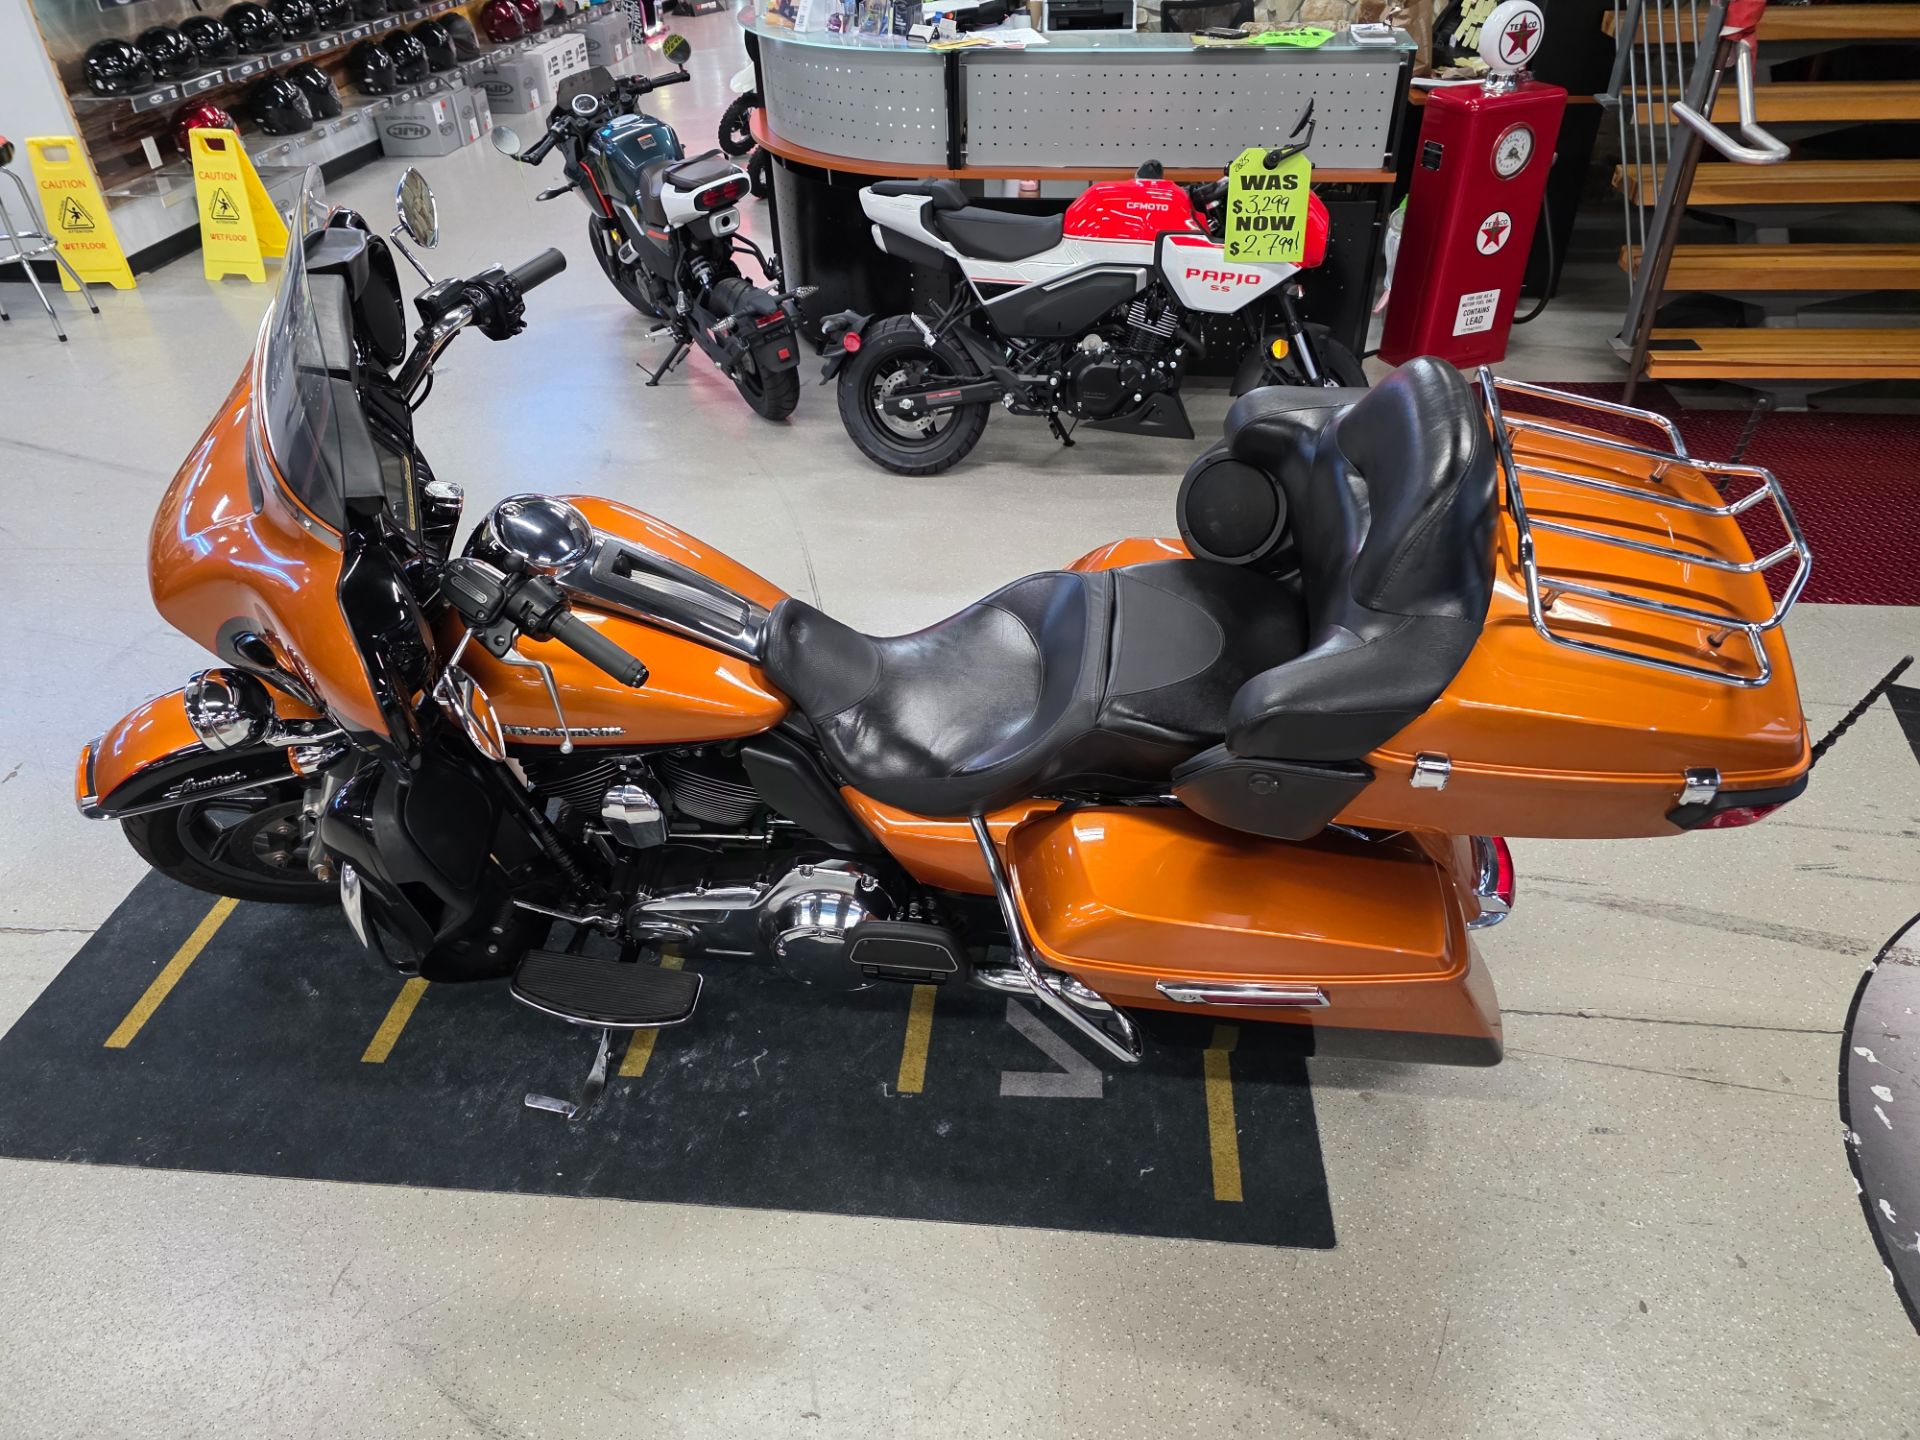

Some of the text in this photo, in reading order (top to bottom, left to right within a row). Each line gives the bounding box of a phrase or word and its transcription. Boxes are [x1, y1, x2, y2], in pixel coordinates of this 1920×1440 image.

[199, 171, 237, 181] CAUTION
[41, 180, 87, 189] CAUTION
[1240, 174, 1299, 191] WAS
[1126, 201, 1169, 211] CFMOTO
[1236, 216, 1296, 231] NOW
[210, 233, 247, 242] WET FLOOR
[1186, 268, 1261, 285] PAPIO
[1210, 285, 1230, 293] SS
[1463, 306, 1491, 317] CONTAINS
[1465, 316, 1484, 326] LEAD
